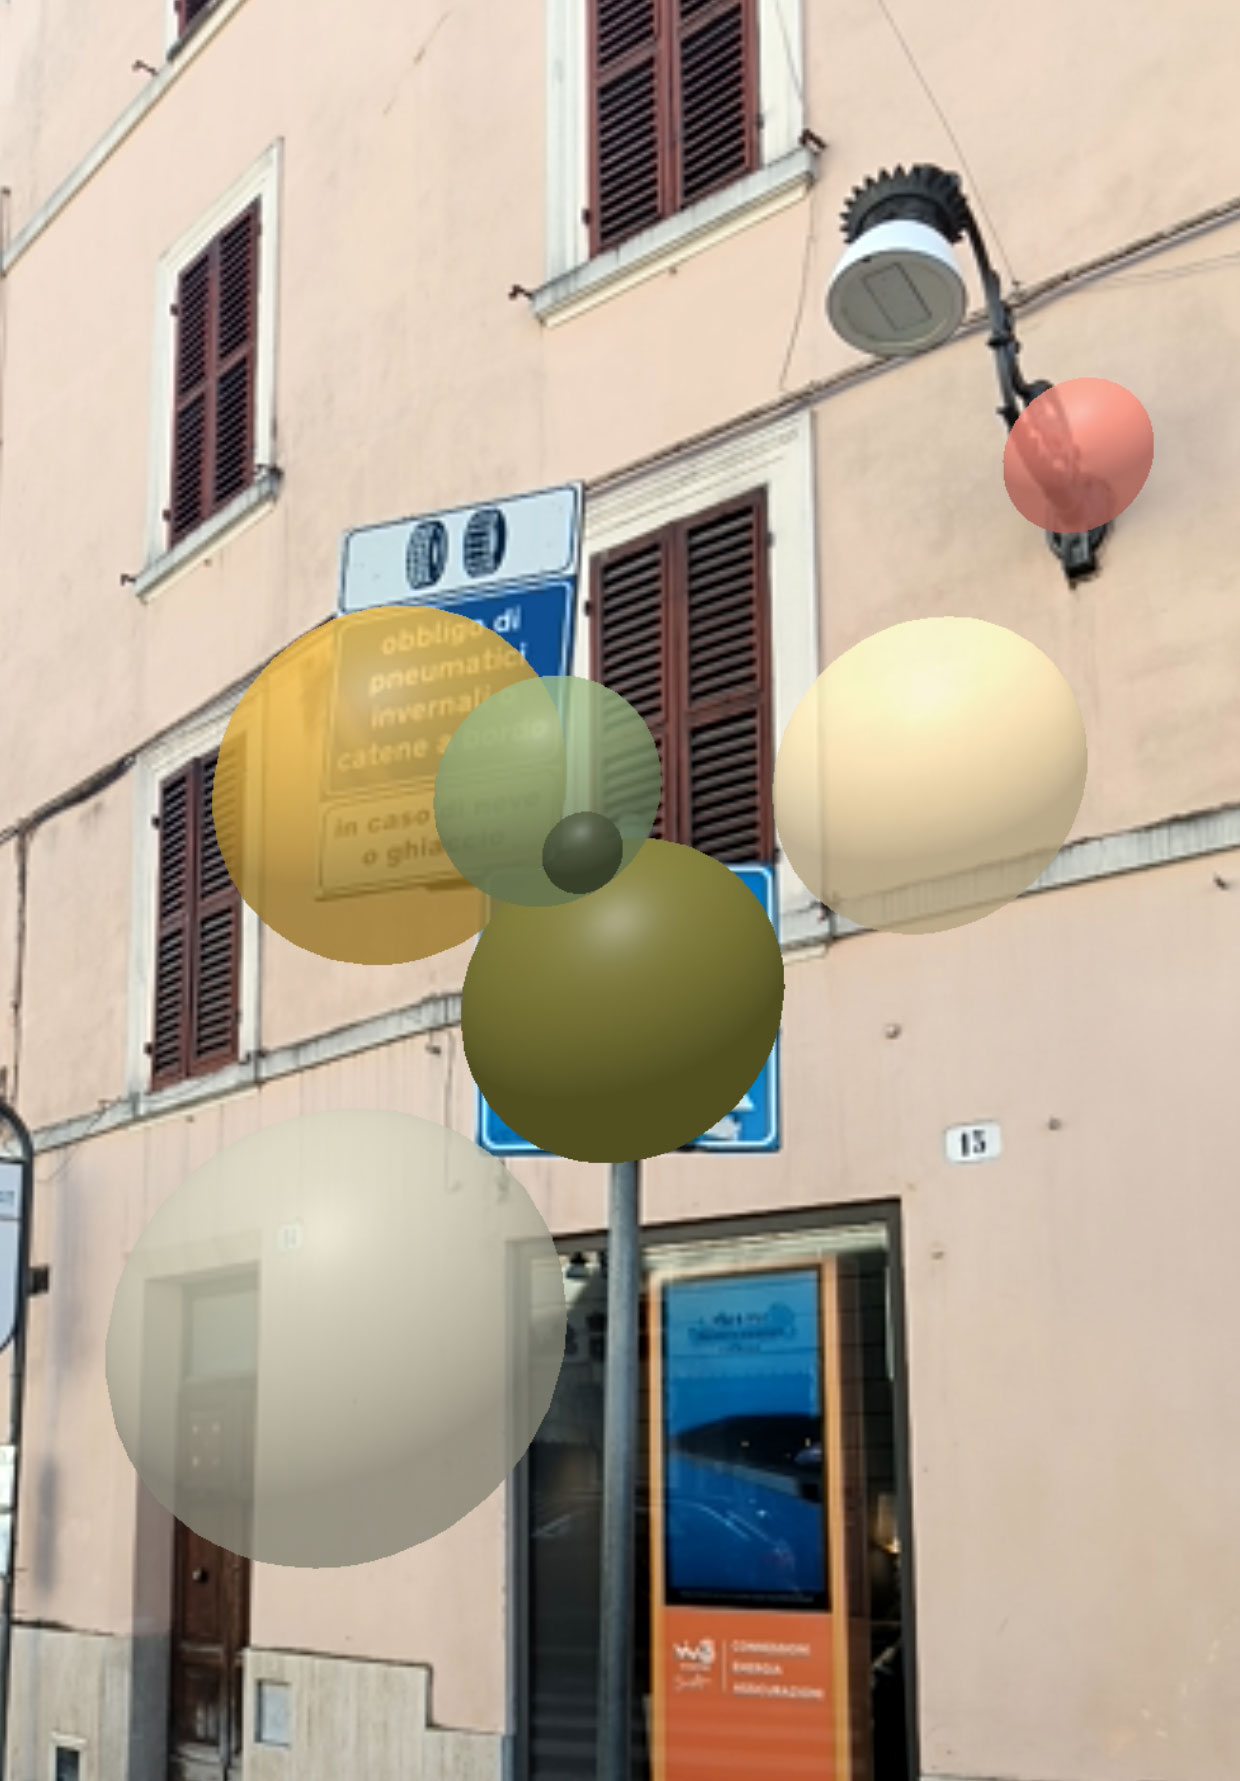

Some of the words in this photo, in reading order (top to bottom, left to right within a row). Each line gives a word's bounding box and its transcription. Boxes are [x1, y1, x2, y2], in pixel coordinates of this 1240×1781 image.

[382, 618, 483, 655] obbligo
[493, 605, 523, 632] di
[368, 643, 527, 697] pneumatici
[371, 684, 491, 729] invernali
[337, 738, 428, 772] catene
[334, 817, 358, 839] in
[367, 806, 431, 833] caso
[363, 848, 378, 867] o
[961, 1129, 986, 1157] 15
